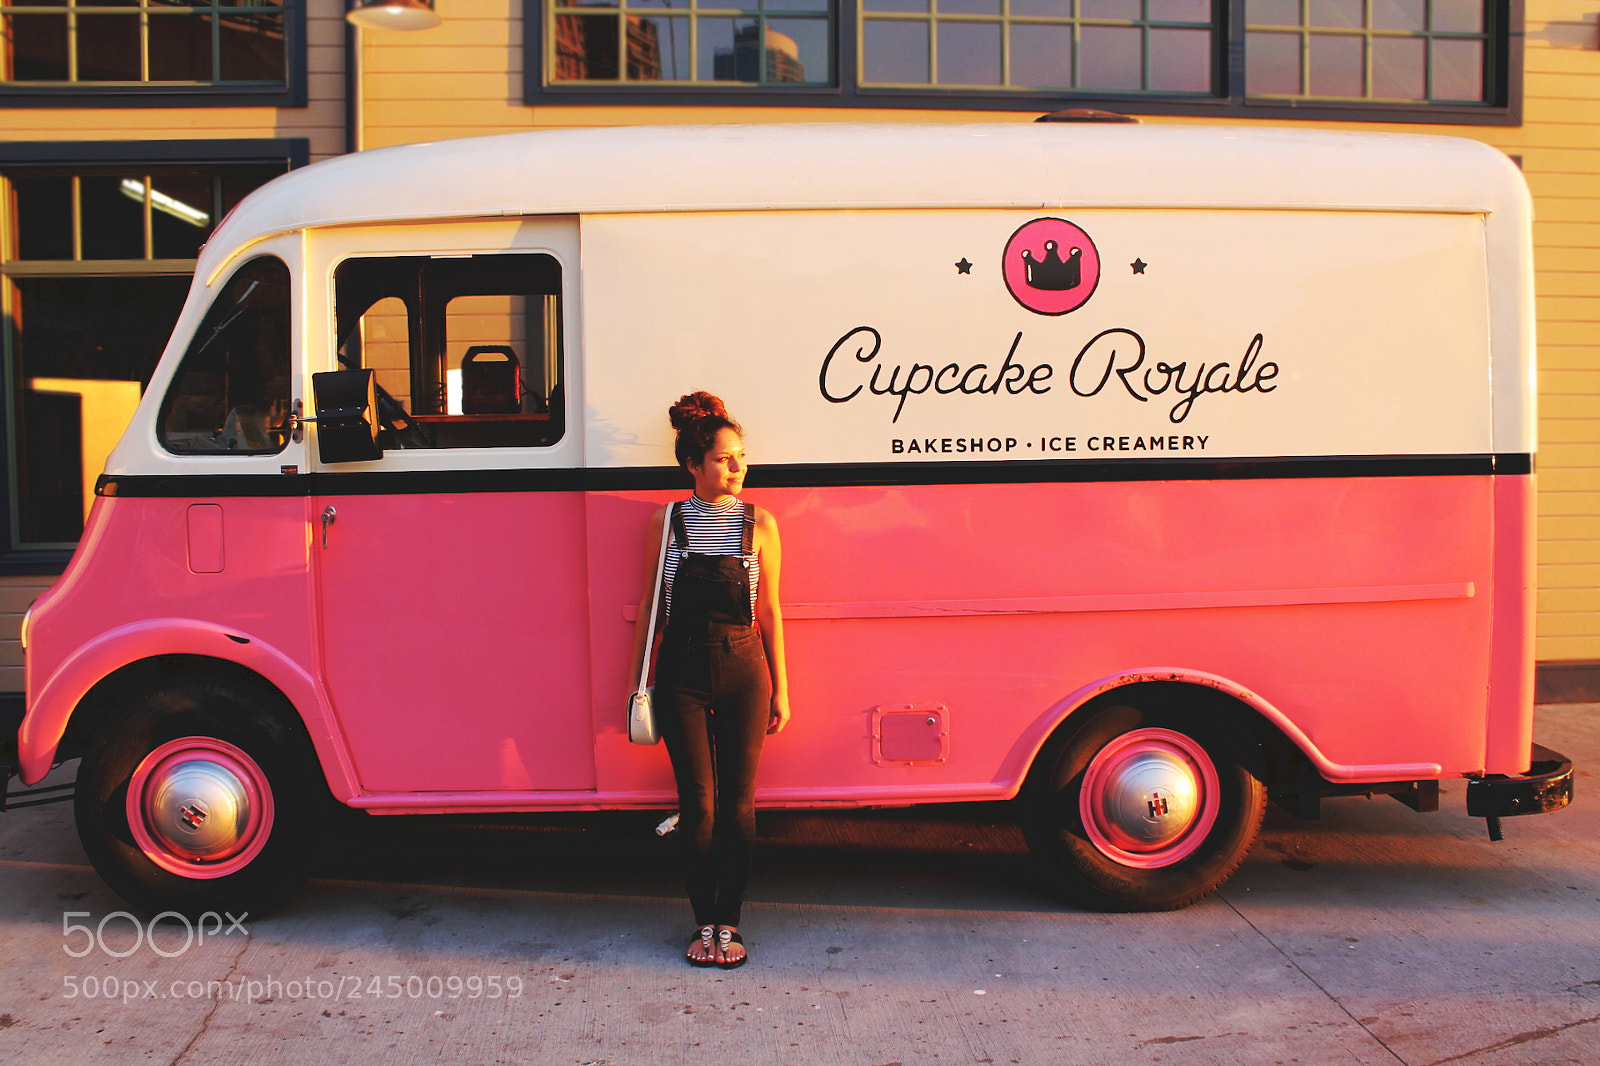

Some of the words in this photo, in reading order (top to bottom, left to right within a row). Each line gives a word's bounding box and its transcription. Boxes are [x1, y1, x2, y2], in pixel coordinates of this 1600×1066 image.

[818, 325, 1054, 424] Cupcake
[1069, 327, 1280, 424] Royale
[891, 437, 1018, 454] BAKESHOP
[1041, 437, 1077, 452] ICE
[1087, 435, 1210, 452] CREAMERY
